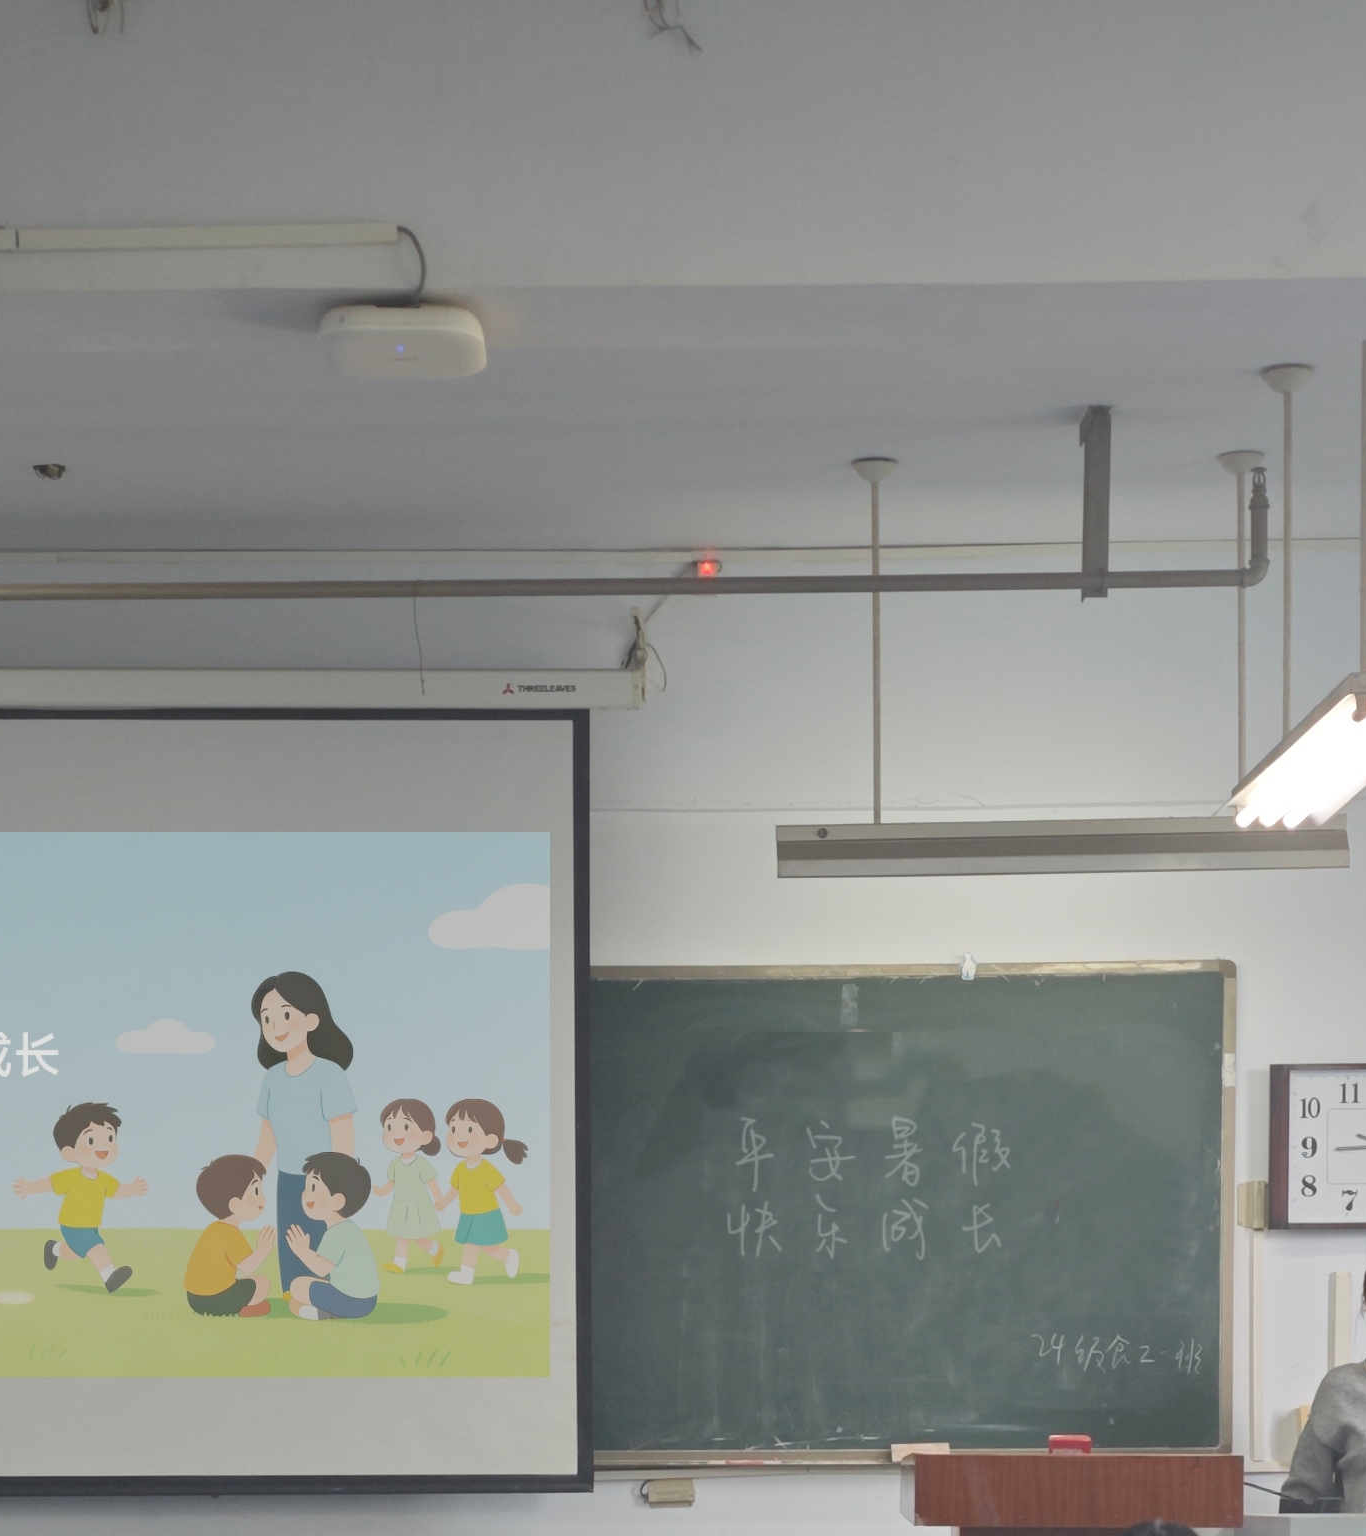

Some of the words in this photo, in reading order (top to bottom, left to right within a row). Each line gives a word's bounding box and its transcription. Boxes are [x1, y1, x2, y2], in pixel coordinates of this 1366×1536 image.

[517, 684, 577, 693] THREELEAVES
[1339, 1082, 1361, 1104] 11
[1299, 1097, 1321, 1119] 10
[735, 1116, 1011, 1192] 平安暑假
[1300, 1136, 1318, 1158] 9
[1300, 1175, 1318, 1197] 8
[1341, 1189, 1358, 1211] 7
[726, 1193, 1002, 1261] 快乐成长
